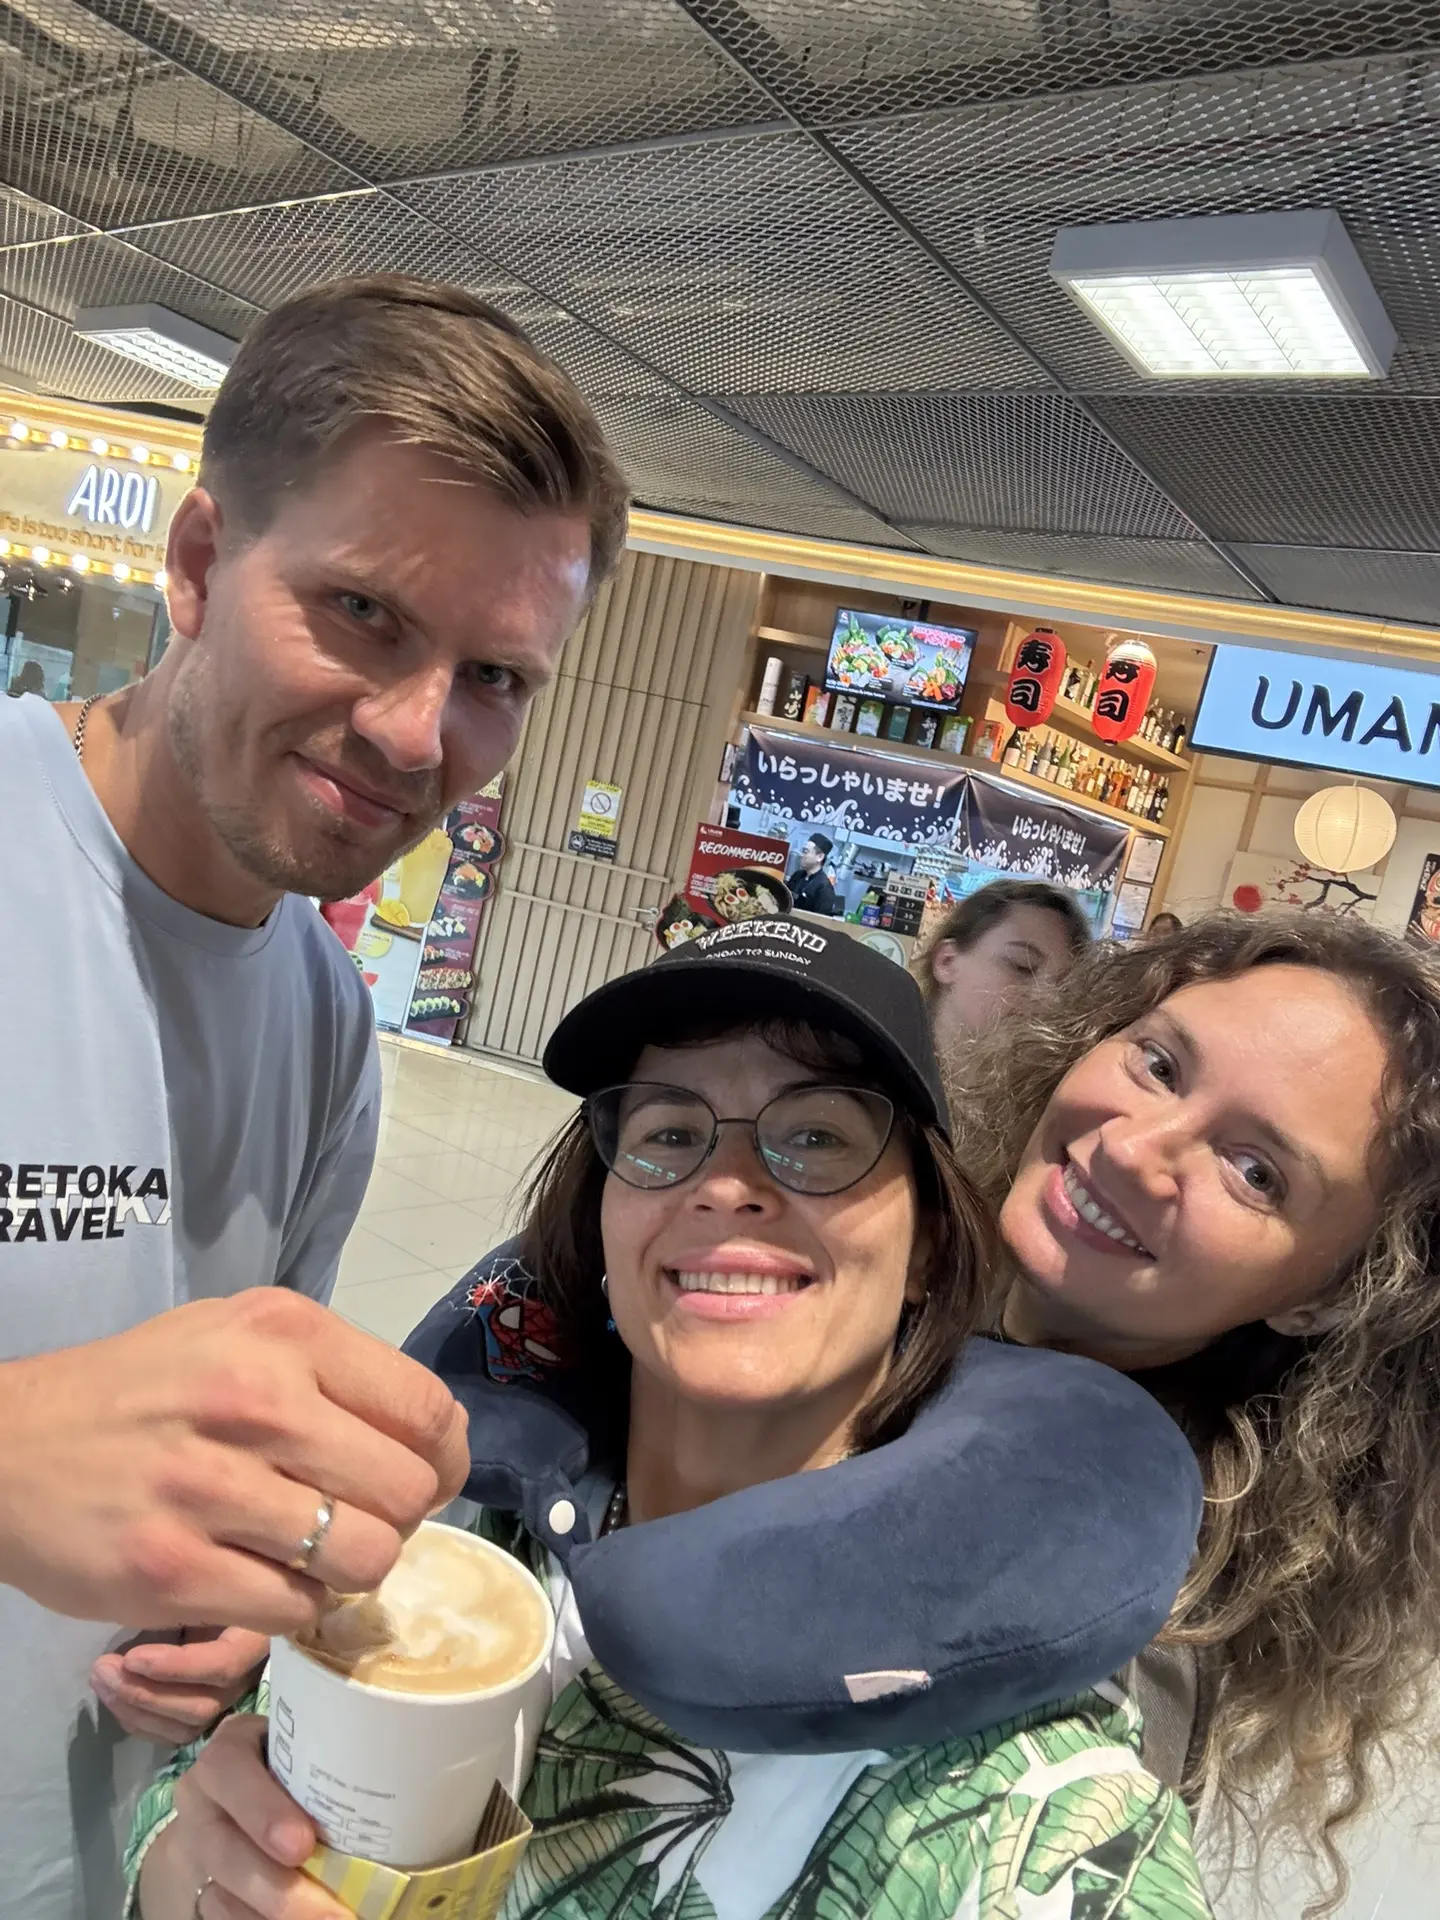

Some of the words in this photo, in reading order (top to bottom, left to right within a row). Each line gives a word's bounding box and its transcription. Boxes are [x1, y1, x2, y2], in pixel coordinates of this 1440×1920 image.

[67, 463, 160, 533] AROI
[70, 526, 122, 553] short
[123, 535, 154, 558] for
[1007, 639, 1053, 712] 寿司
[698, 841, 784, 864] RECOMMENDED
[694, 921, 827, 952] WEEKEND
[746, 949, 762, 957] TO
[765, 950, 811, 965] SUNDAY
[0, 1206, 125, 1242] RAVEL
